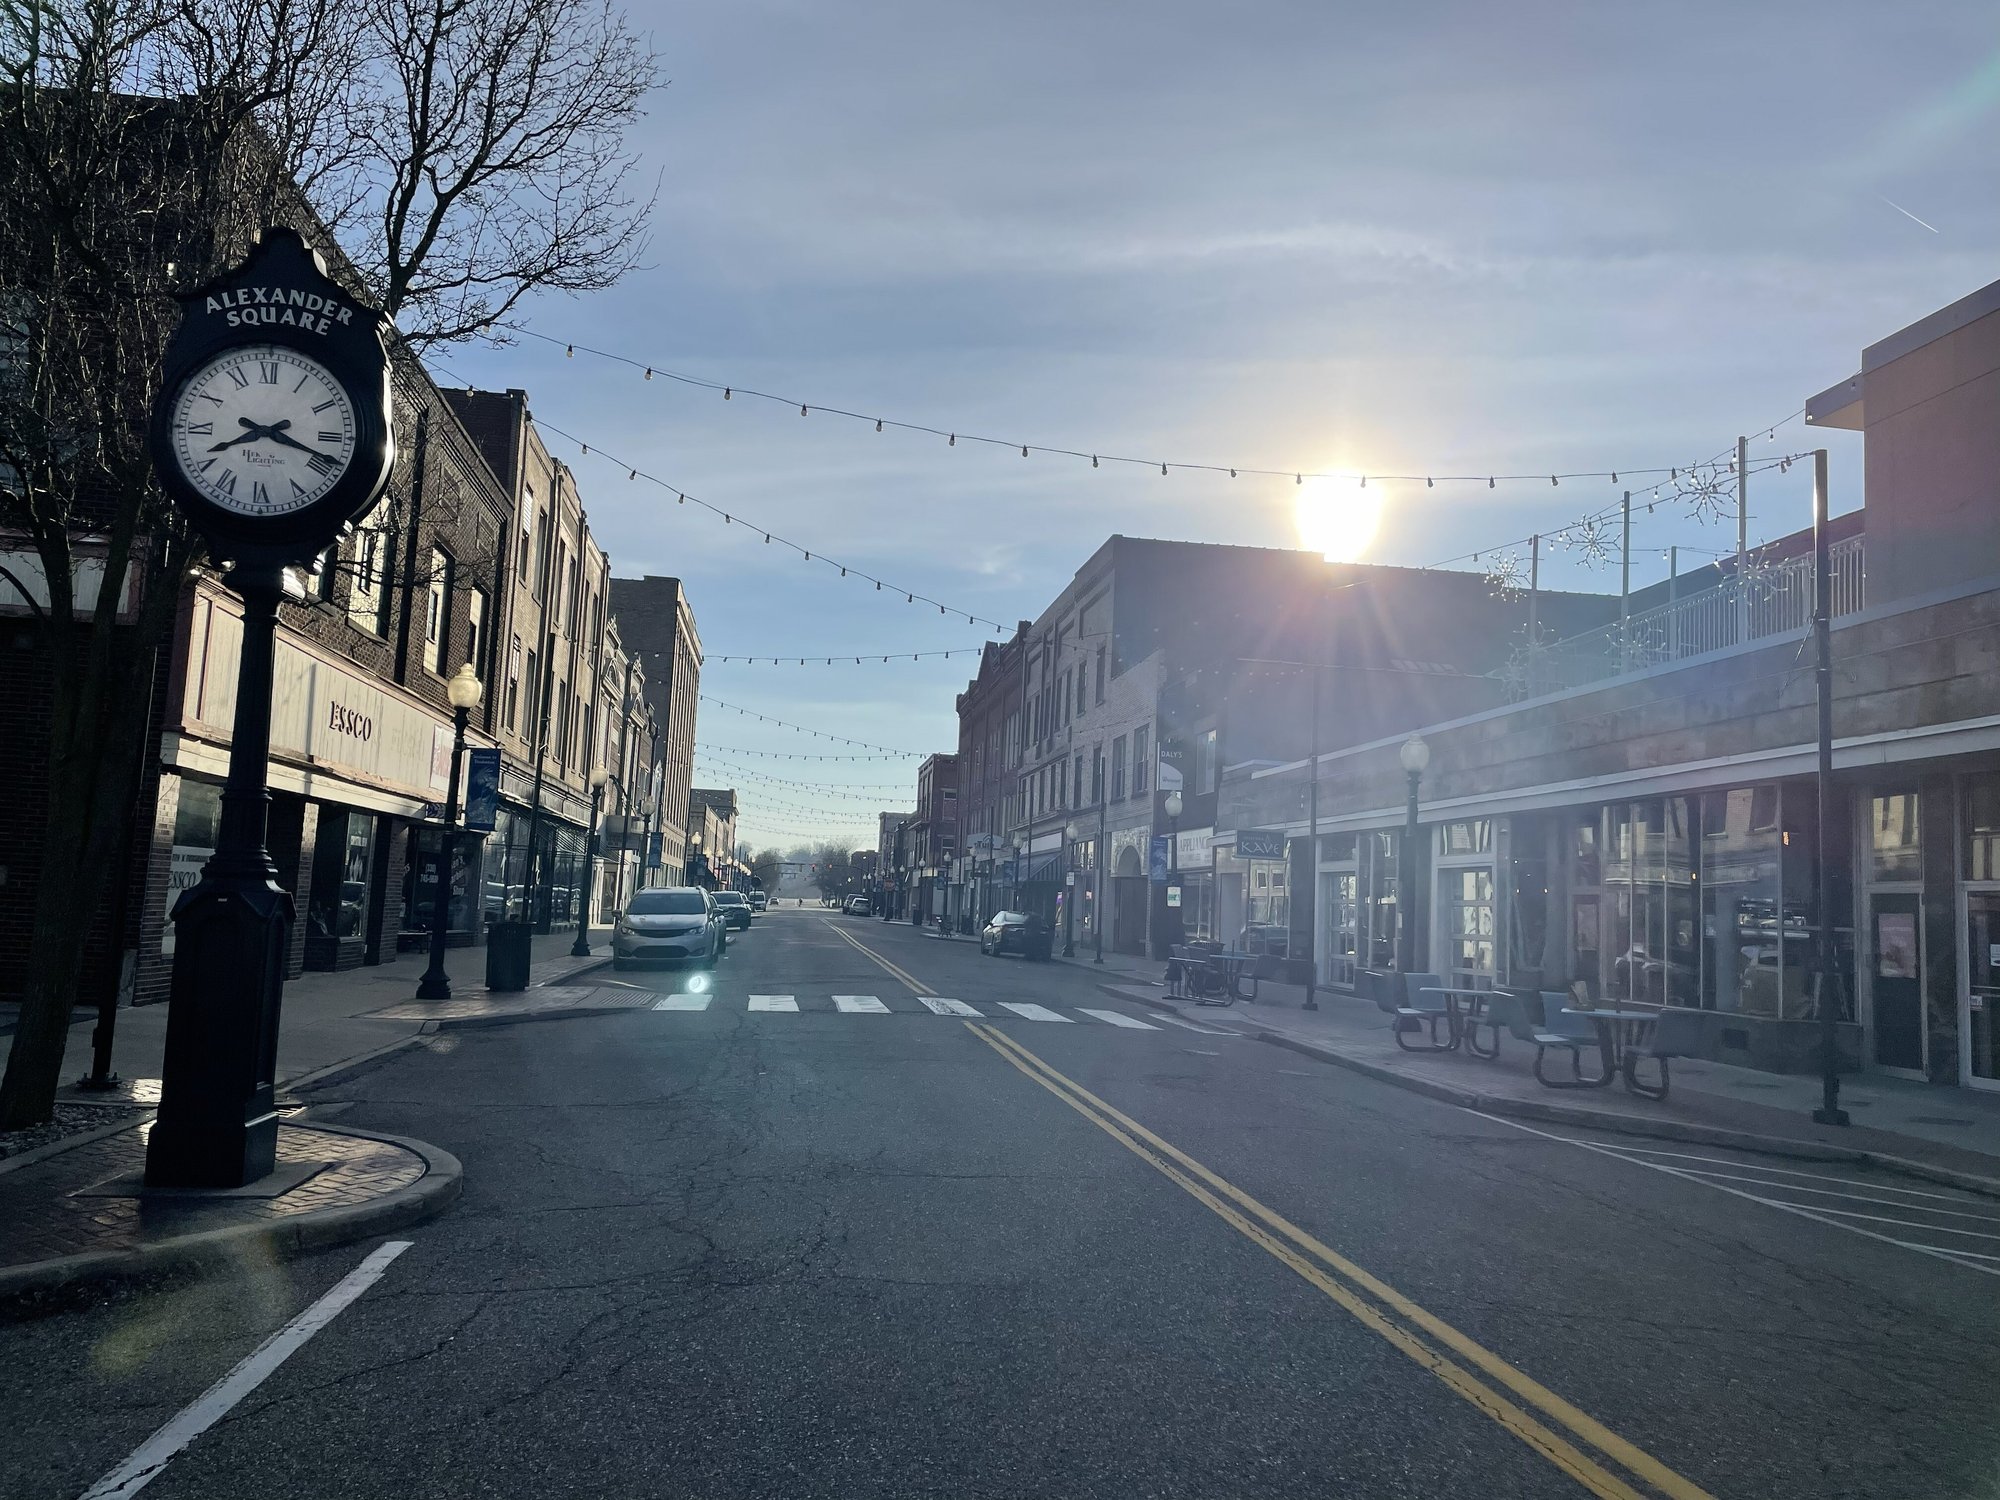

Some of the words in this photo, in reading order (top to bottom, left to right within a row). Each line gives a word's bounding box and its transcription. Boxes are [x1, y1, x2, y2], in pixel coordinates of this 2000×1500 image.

[206, 287, 353, 326] ALEXANDER
[226, 306, 331, 336] SQUARE
[226, 366, 250, 391] XI
[258, 361, 279, 385] XII
[199, 389, 224, 408] X
[188, 421, 213, 435] IX
[252, 481, 271, 504] VI
[329, 700, 372, 742] ESSCO
[1241, 841, 1280, 855] KAVE
